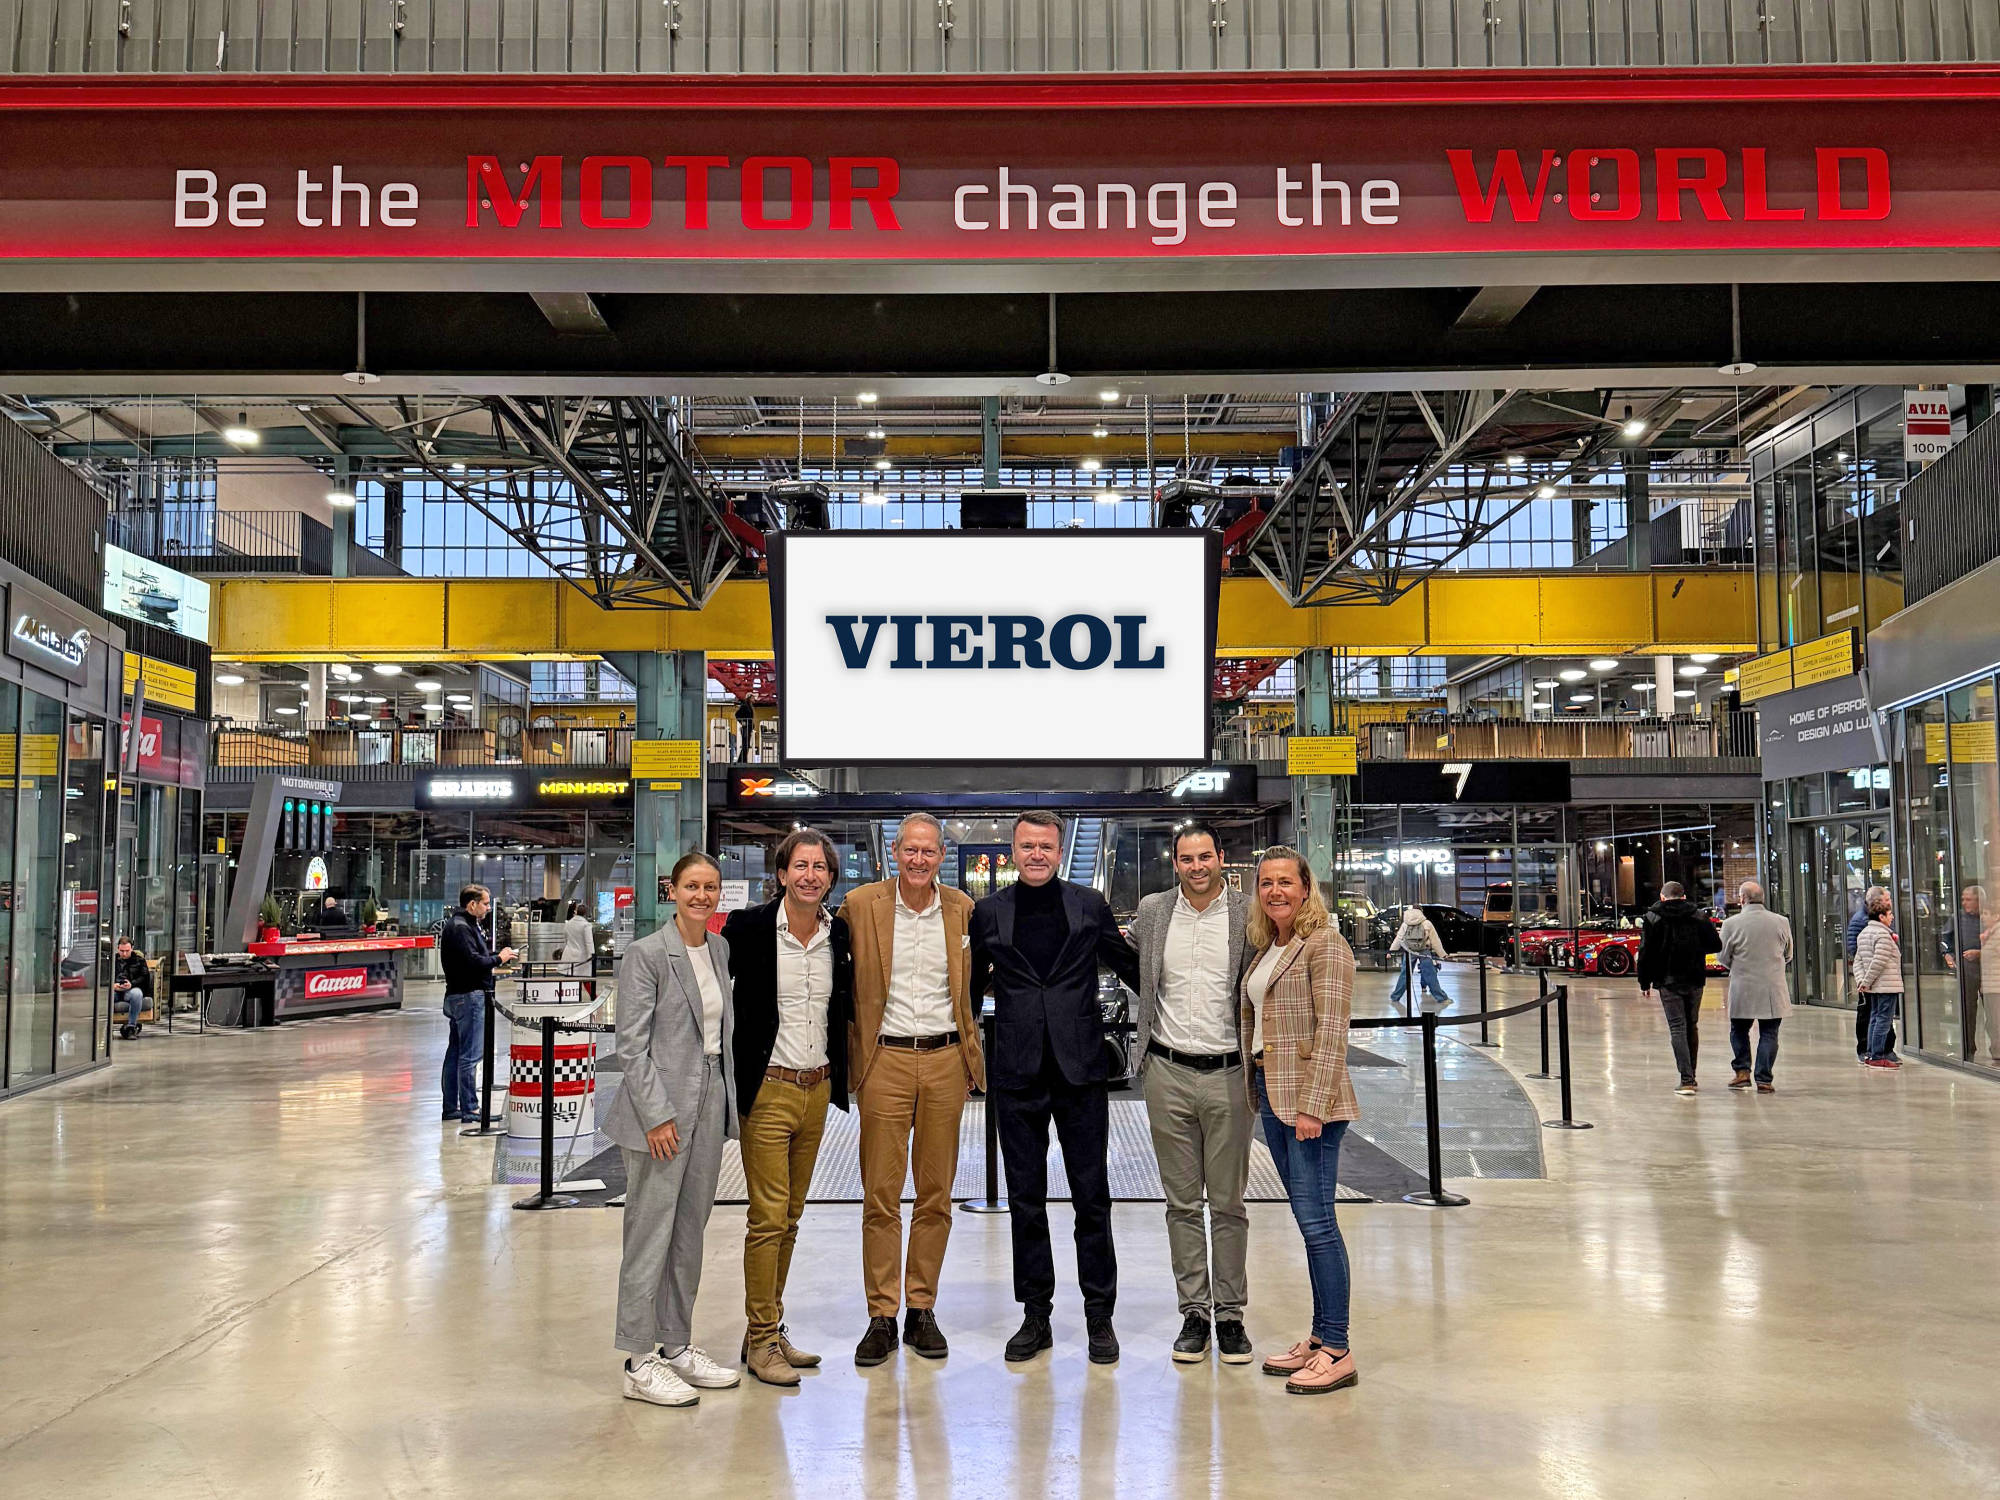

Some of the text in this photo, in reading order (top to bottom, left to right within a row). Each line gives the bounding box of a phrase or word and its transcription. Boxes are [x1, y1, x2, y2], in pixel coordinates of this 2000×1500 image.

[174, 147, 1891, 245] Be the MOTOR change the WORLD
[1908, 404, 1948, 414] AVIA
[16, 615, 85, 664] McLaren
[825, 613, 1165, 671] VIEROL
[1789, 710, 1816, 726] HOME
[1817, 706, 1830, 719] OF
[1798, 725, 1830, 743] DESIGN
[1832, 720, 1854, 735] AND
[281, 777, 334, 792] MOTORWORLD
[430, 781, 513, 797] BRABUS
[540, 782, 629, 794] MANHART
[1171, 771, 1231, 797] ABT
[309, 973, 364, 994] Carrera
